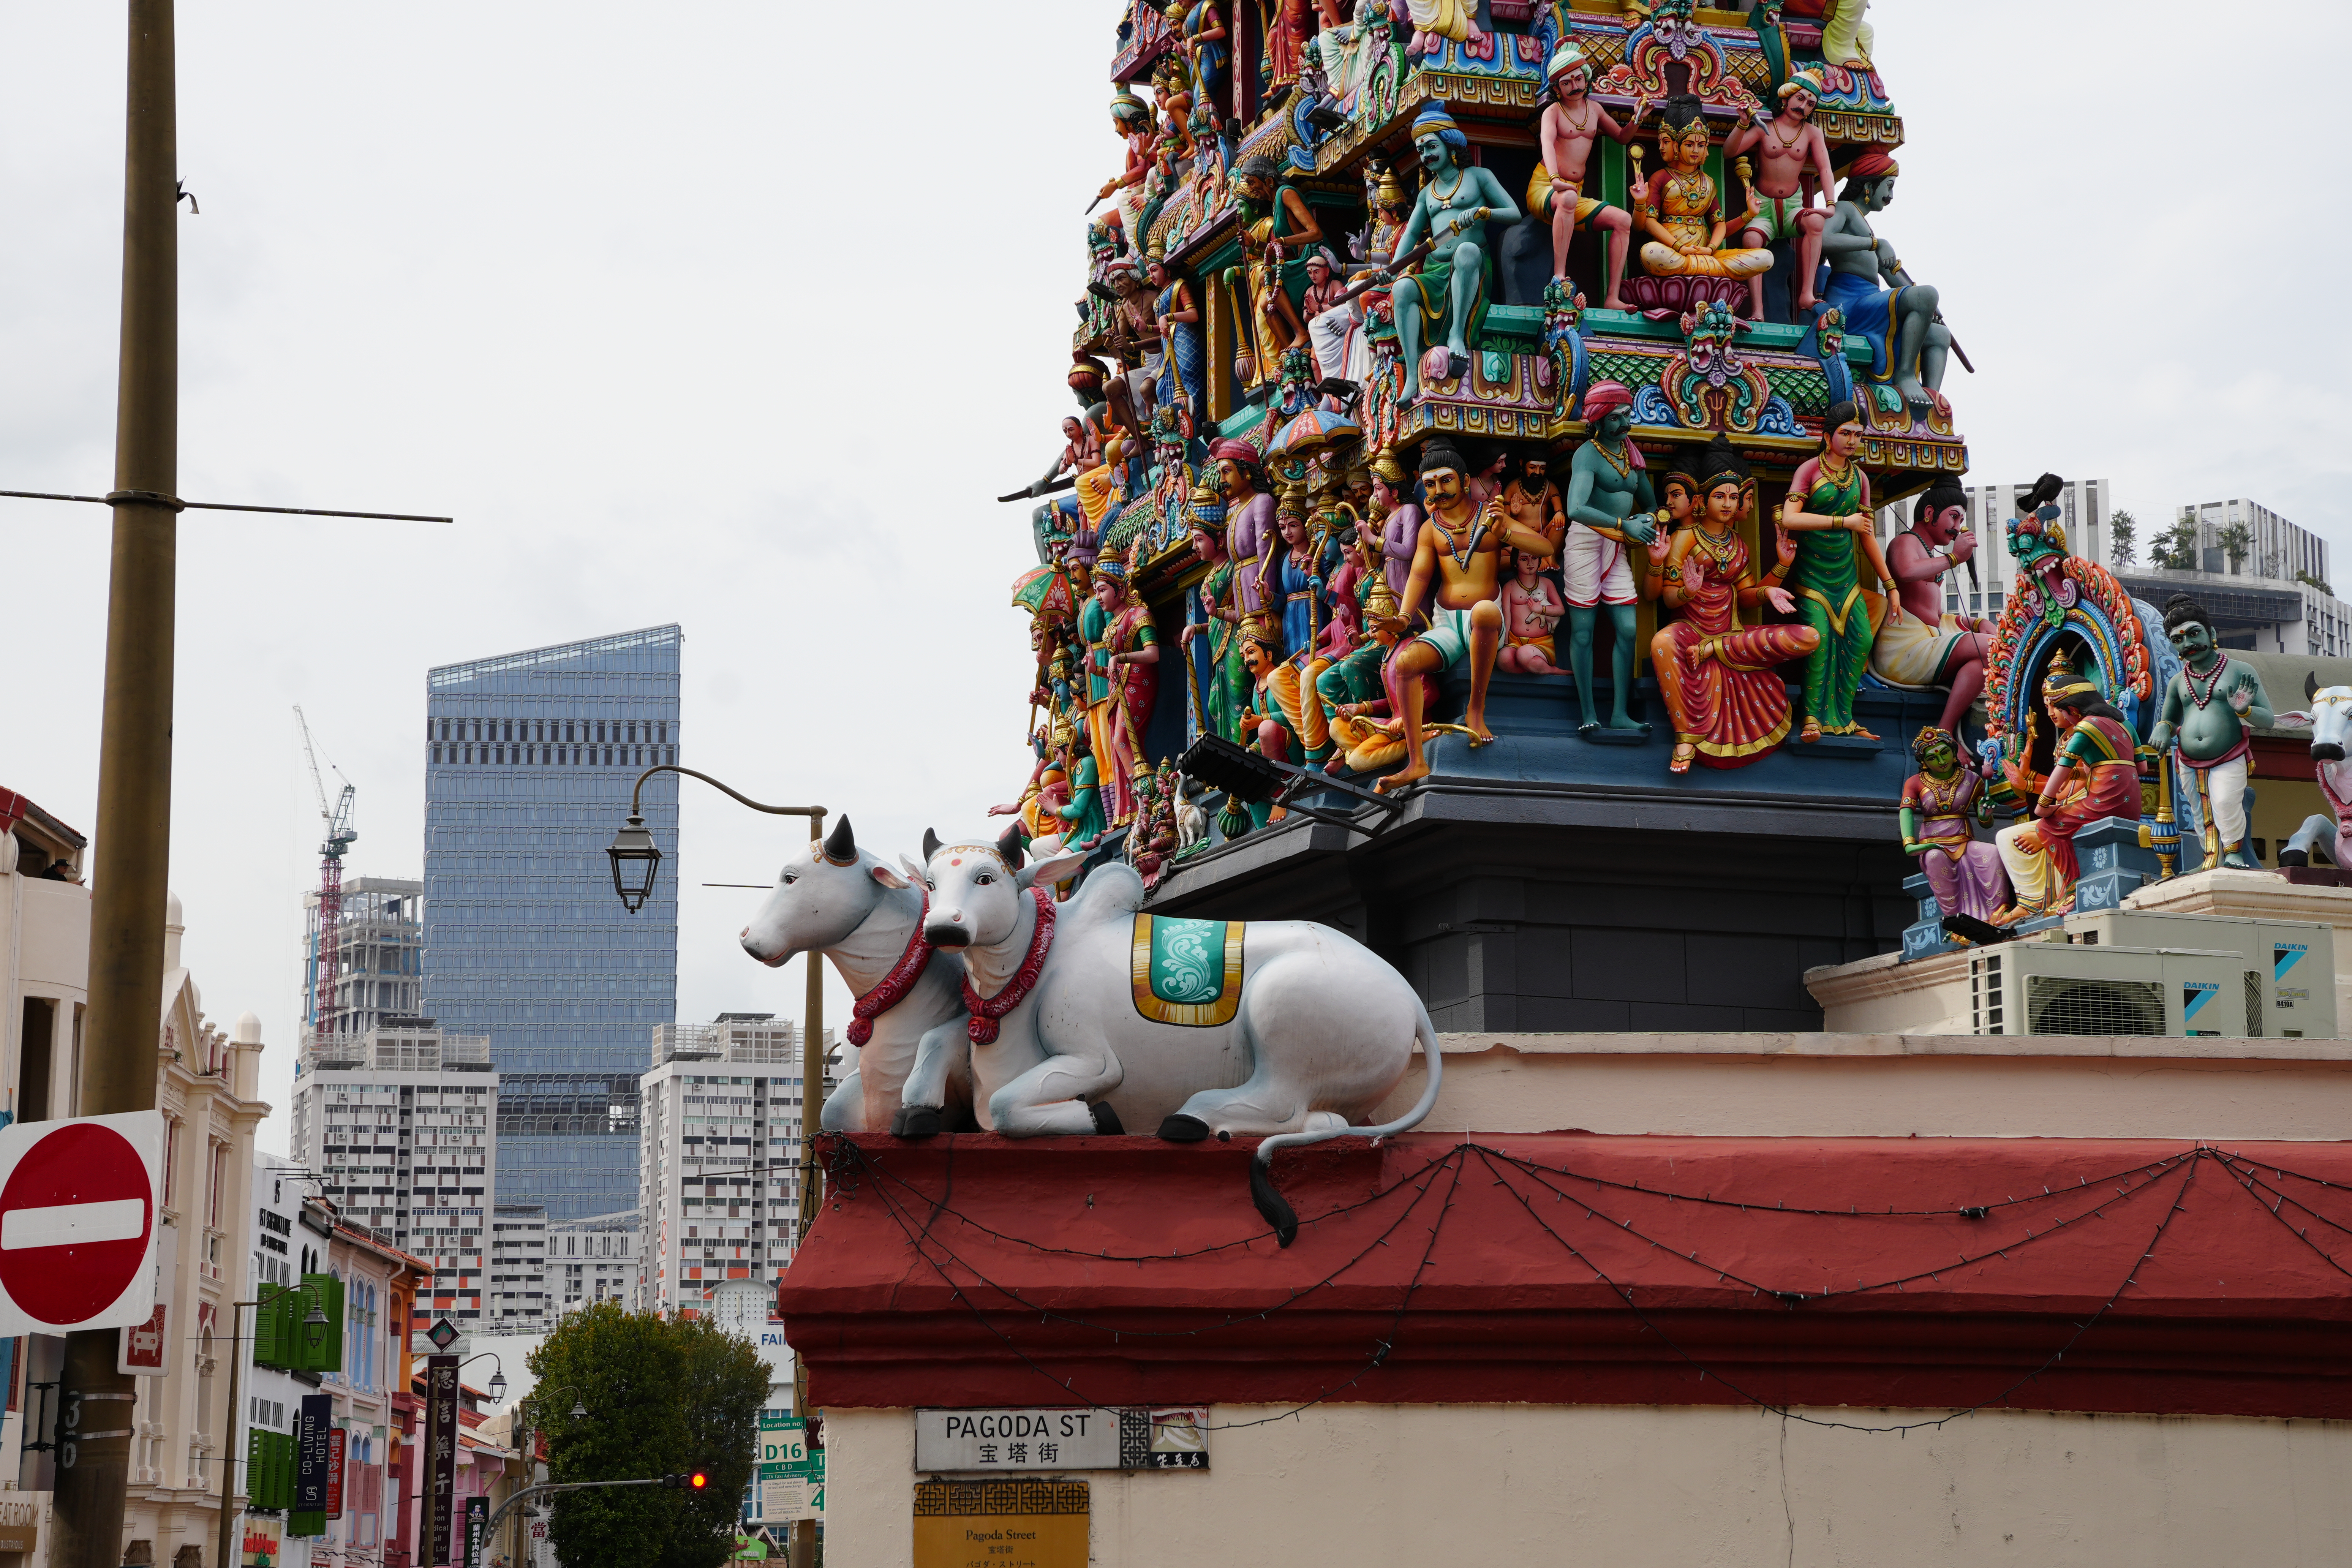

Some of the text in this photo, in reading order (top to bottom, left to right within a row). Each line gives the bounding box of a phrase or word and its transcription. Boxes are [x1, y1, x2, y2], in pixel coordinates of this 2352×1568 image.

[165, 1025, 173, 1048] 1910
[762, 1334, 786, 1345] FAI
[947, 1415, 1091, 1438] PAGODA ST
[303, 1416, 314, 1475] CO-LIVING
[316, 1427, 326, 1462] HOTEL
[765, 1443, 801, 1460] D16
[979, 1442, 1058, 1463] 宝塔街
[811, 1490, 825, 1511] 4
[14, 1503, 39, 1527] ROOM
[531, 1522, 547, 1538] 當
[966, 1529, 1036, 1543] Pagoda Street
[988, 1545, 1013, 1554] 宝塔街
